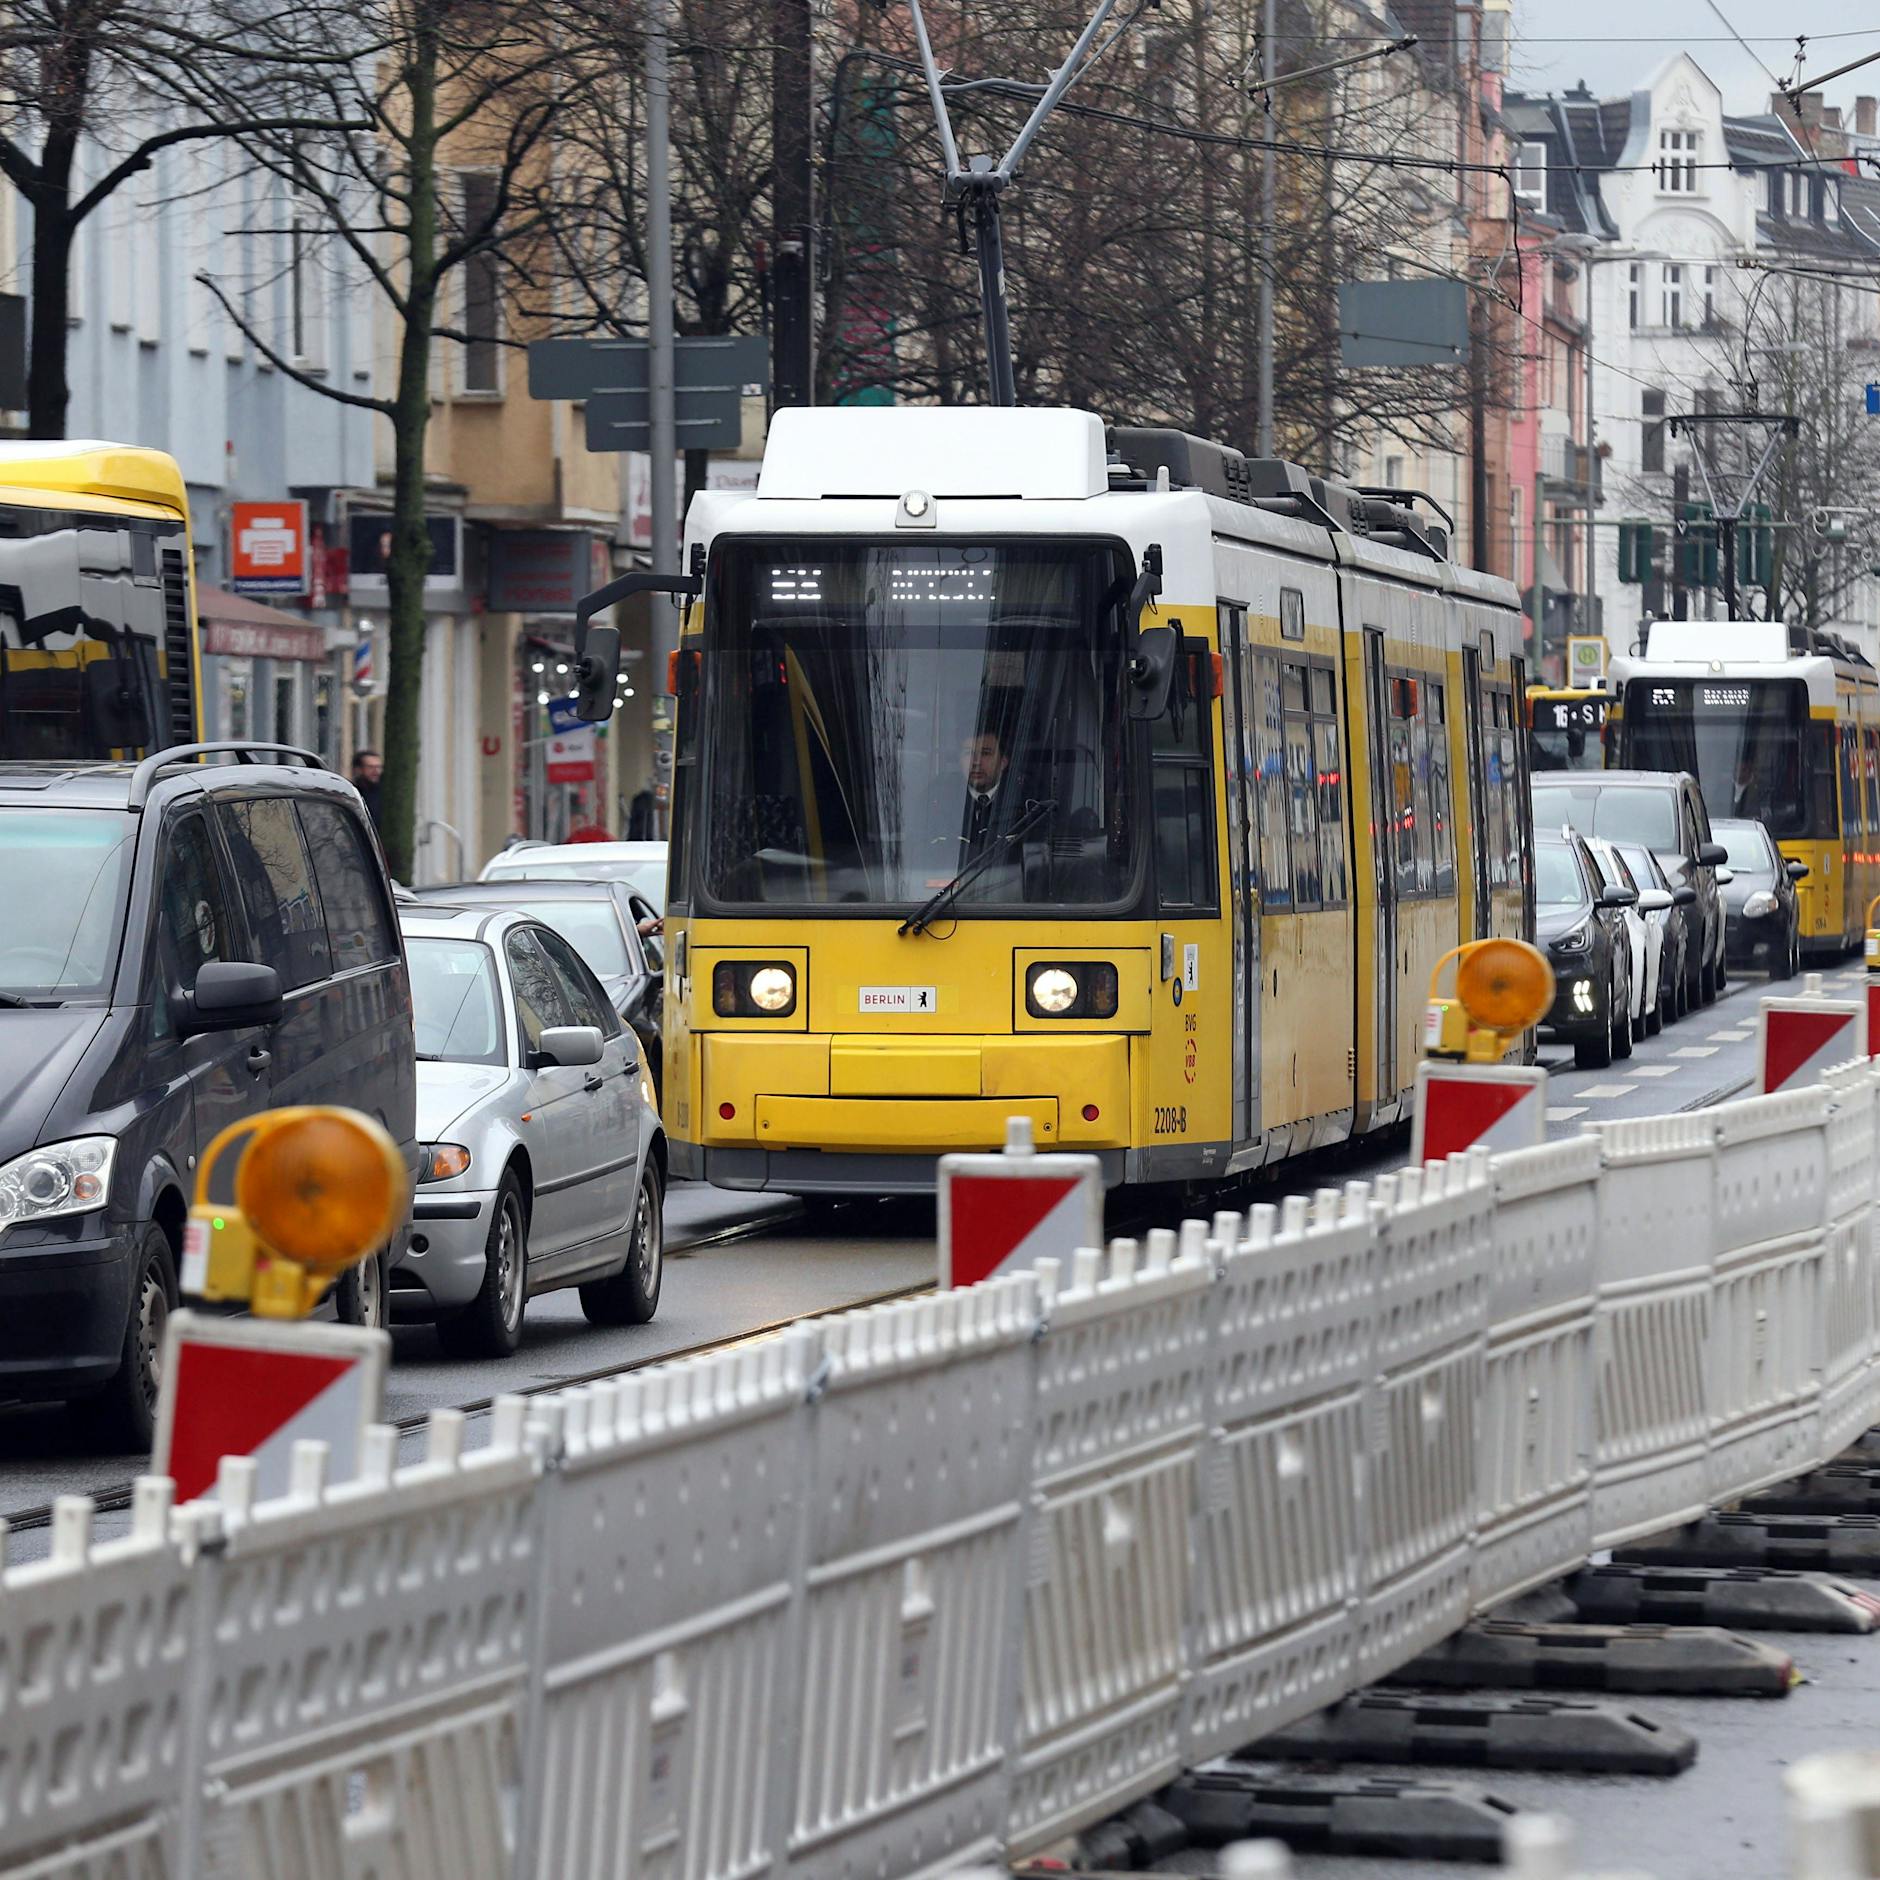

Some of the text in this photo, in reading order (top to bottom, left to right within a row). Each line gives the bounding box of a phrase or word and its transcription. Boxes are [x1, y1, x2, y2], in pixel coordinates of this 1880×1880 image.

[864, 994, 905, 1005] BERLIN
[1185, 1014, 1197, 1031] BVG
[1154, 1105, 1187, 1134] 2208-B
